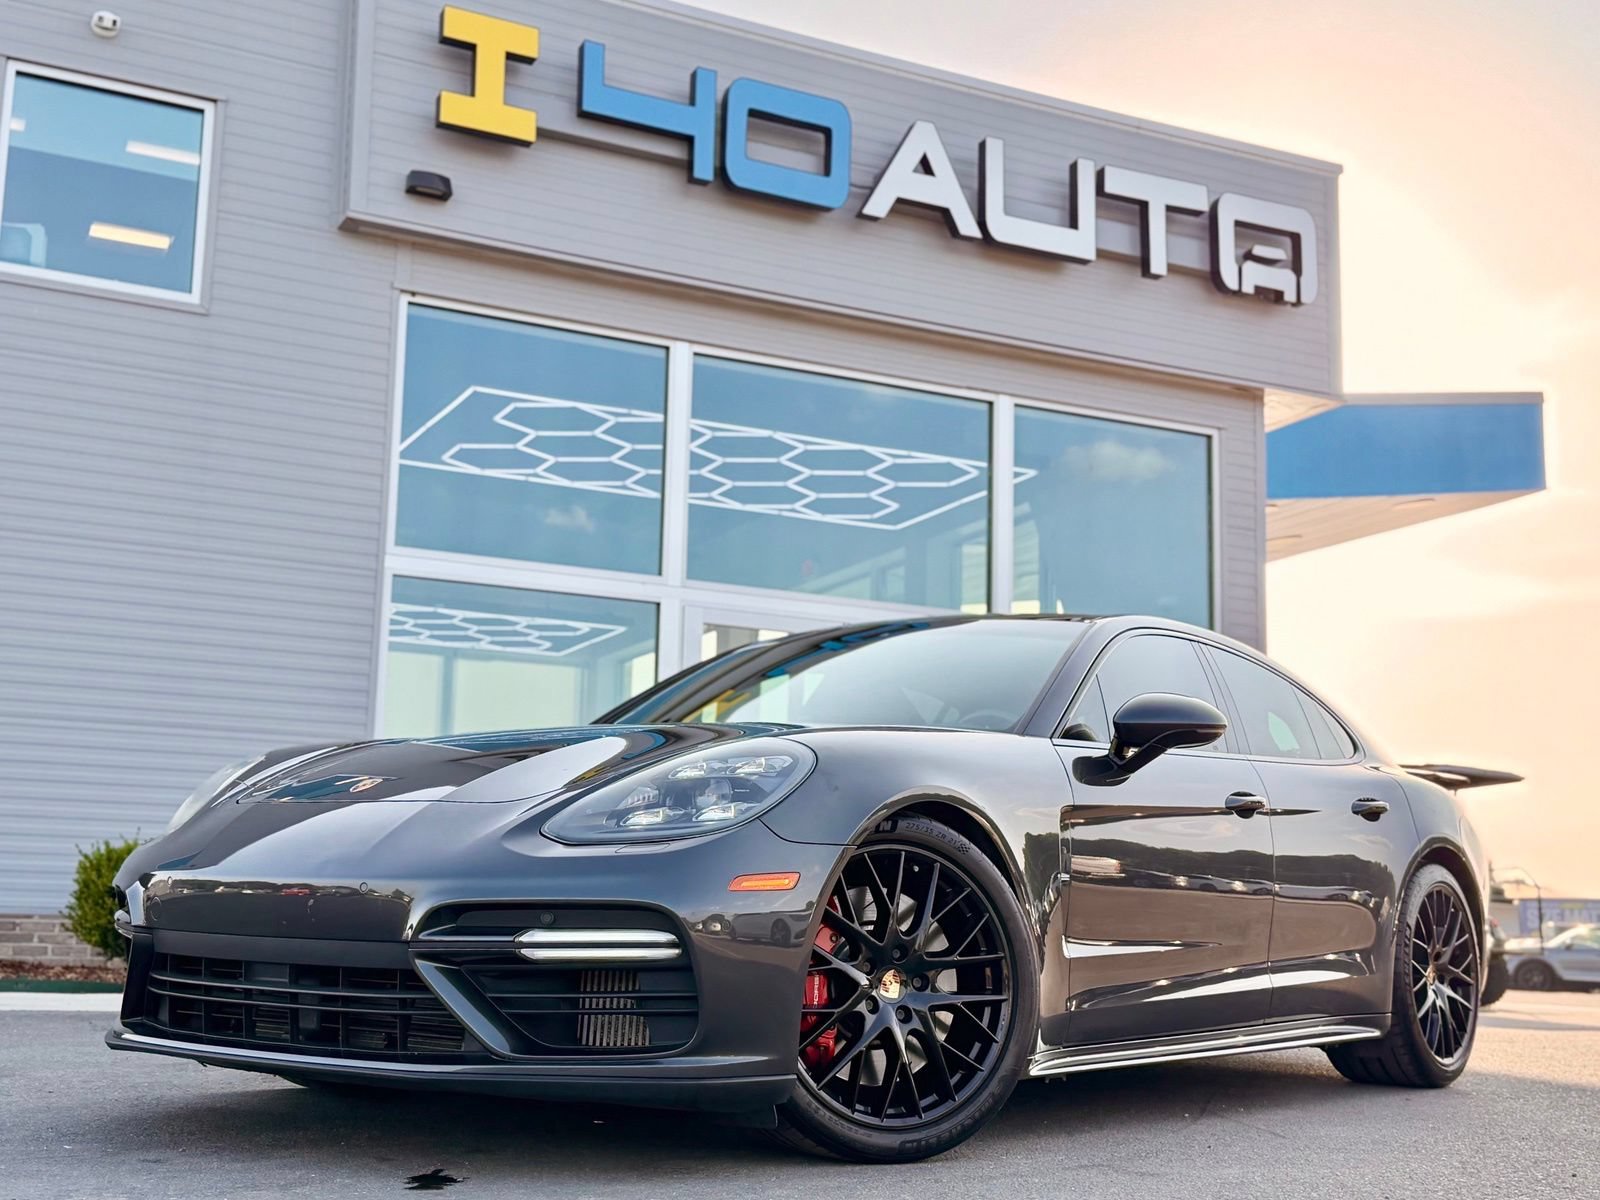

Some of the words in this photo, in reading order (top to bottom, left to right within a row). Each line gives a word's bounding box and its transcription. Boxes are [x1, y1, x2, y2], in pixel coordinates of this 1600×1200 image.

[860, 120, 1319, 306] AUTO
[905, 821, 934, 835] 275/35
[935, 830, 946, 840] ZR
